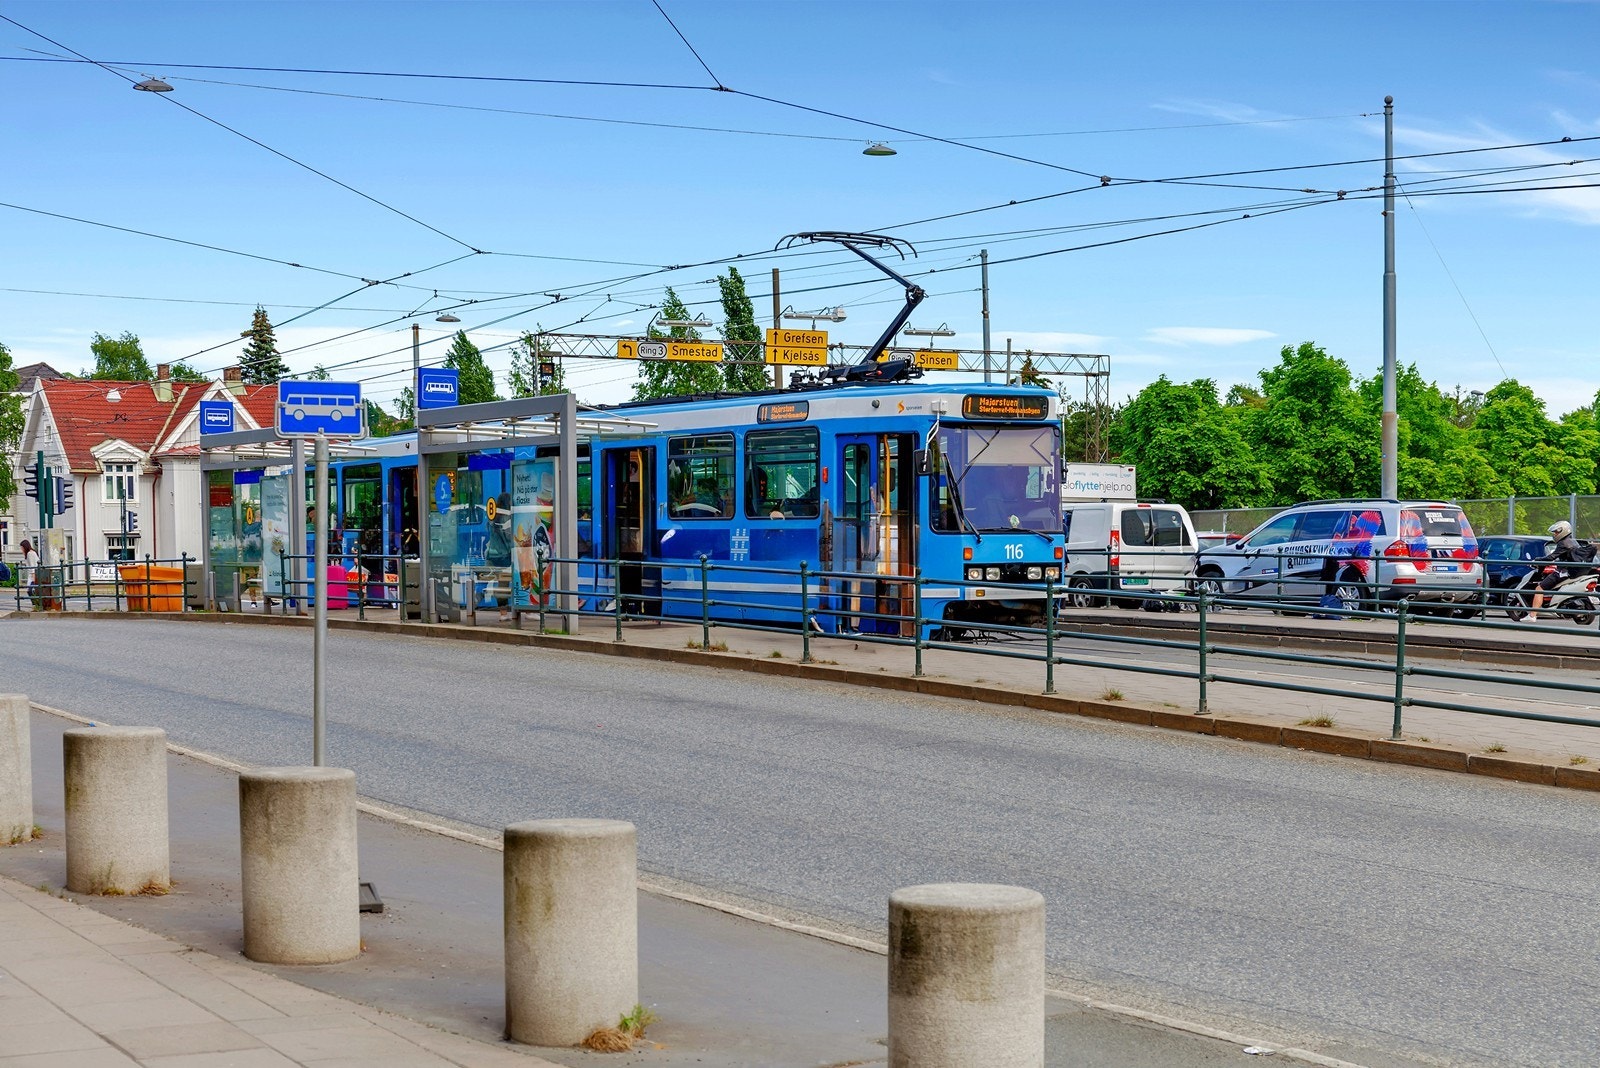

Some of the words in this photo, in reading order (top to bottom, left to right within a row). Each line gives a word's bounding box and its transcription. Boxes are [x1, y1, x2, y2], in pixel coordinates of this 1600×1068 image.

[784, 332, 824, 344] Grefsen
[640, 347, 657, 356] Ring
[658, 346, 664, 355] 3
[672, 345, 718, 357] Smestad
[783, 349, 820, 363] Kjelsås
[919, 354, 952, 366] Sinsen
[761, 406, 768, 421] 11
[1060, 480, 1133, 493] sloflyttehjelp.no
[248, 510, 252, 520] A
[489, 502, 494, 516] B
[1004, 543, 1024, 560] 116
